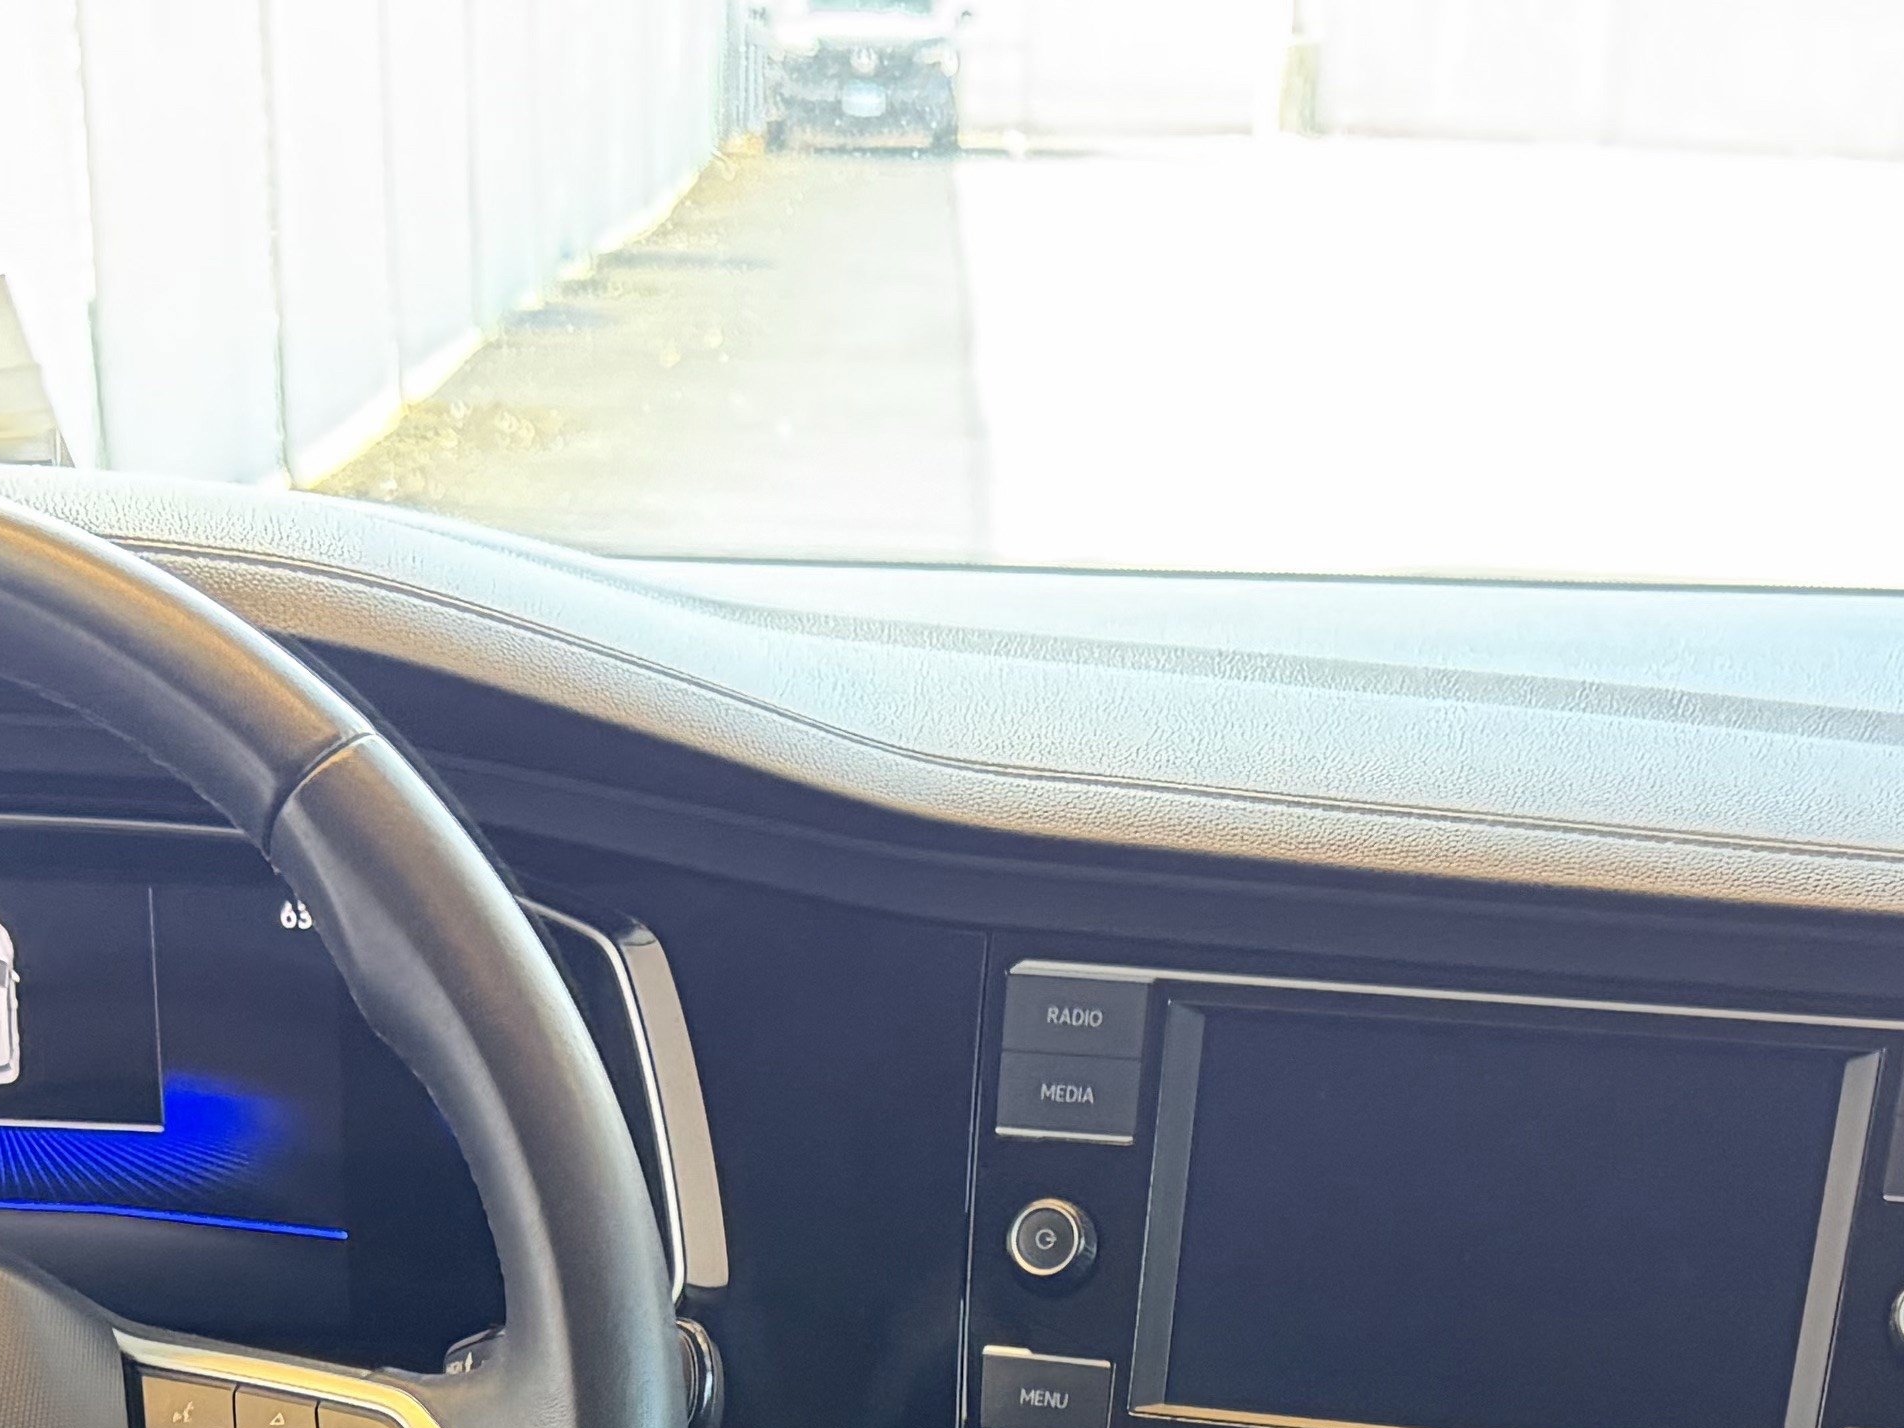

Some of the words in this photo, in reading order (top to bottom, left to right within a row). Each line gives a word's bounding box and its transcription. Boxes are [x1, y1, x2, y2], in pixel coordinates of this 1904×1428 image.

[1046, 1006, 1103, 1028] RADIO
[1040, 1082, 1094, 1104] MEDIA
[1019, 1388, 1069, 1409] MENU
